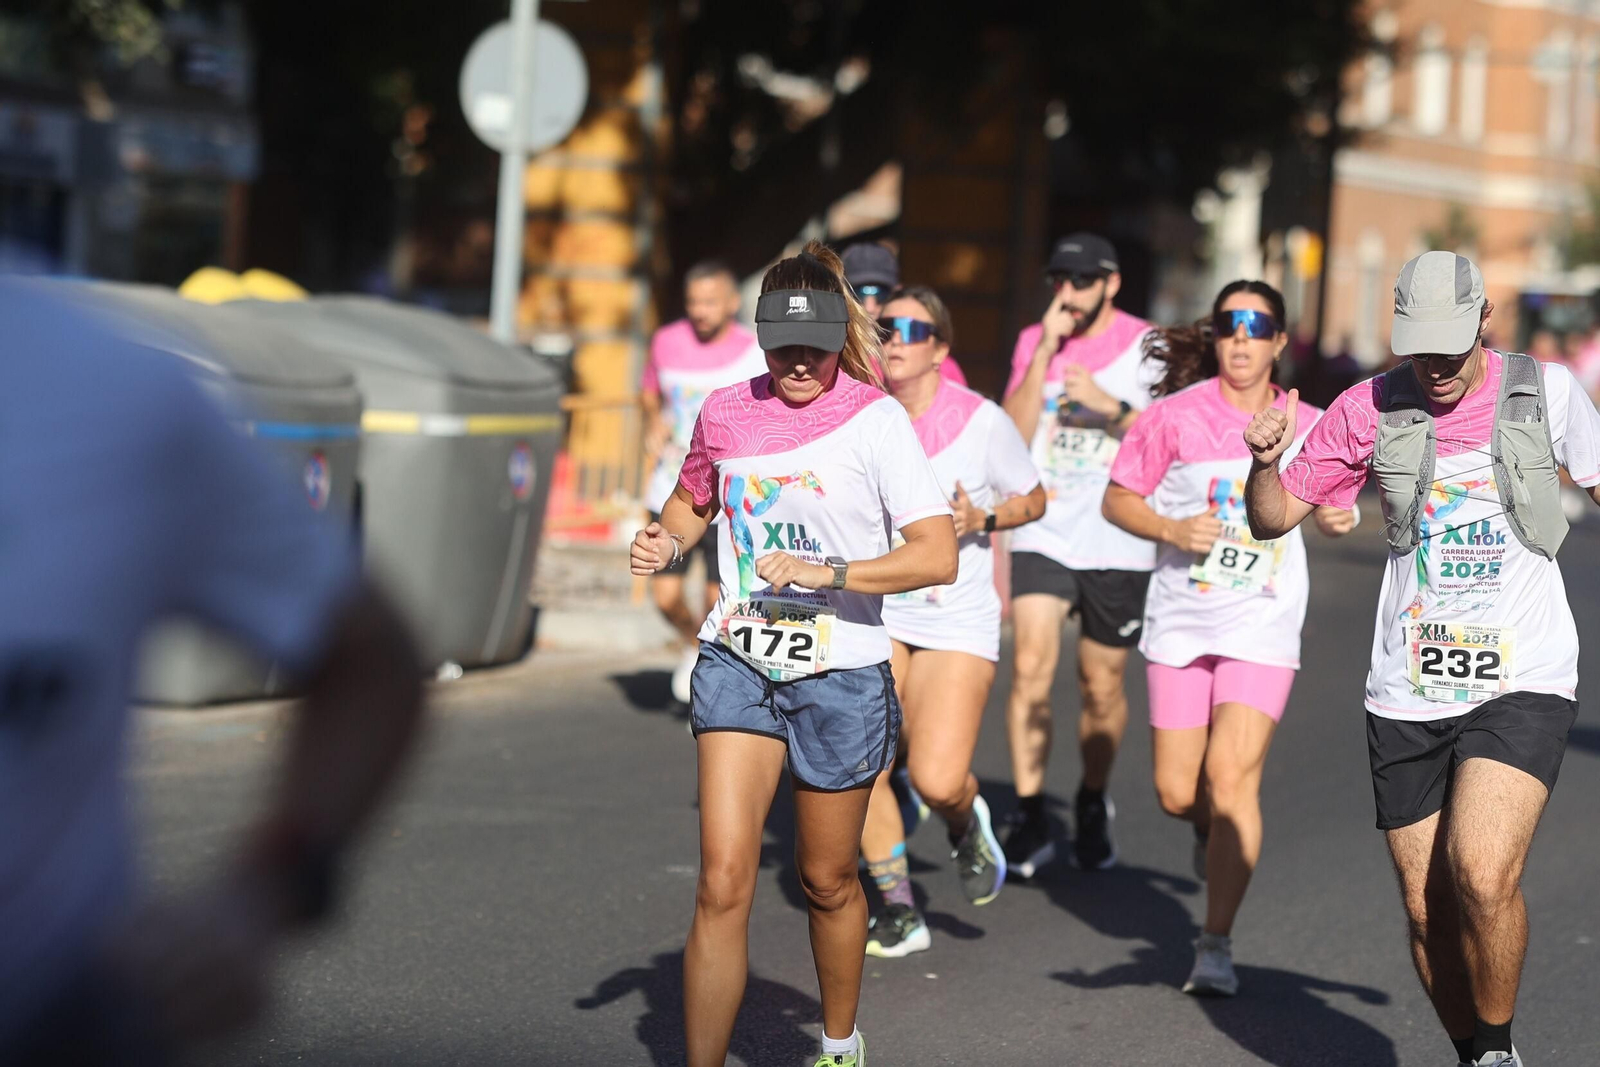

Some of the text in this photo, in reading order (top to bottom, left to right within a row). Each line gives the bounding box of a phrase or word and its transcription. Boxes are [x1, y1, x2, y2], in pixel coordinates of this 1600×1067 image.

[1052, 433, 1104, 452] 427
[762, 521, 822, 553] XII 10k
[1440, 519, 1507, 546] XII 10k
[1220, 547, 1259, 572] 87
[1475, 548, 1506, 556] URBANA
[1440, 561, 1503, 579] 2025
[750, 609, 771, 620] 10k
[778, 611, 816, 624] 2025
[1418, 623, 1456, 643] XII 10k
[1462, 634, 1500, 645] 2025
[733, 626, 813, 662] 172
[1421, 647, 1500, 681] 232
